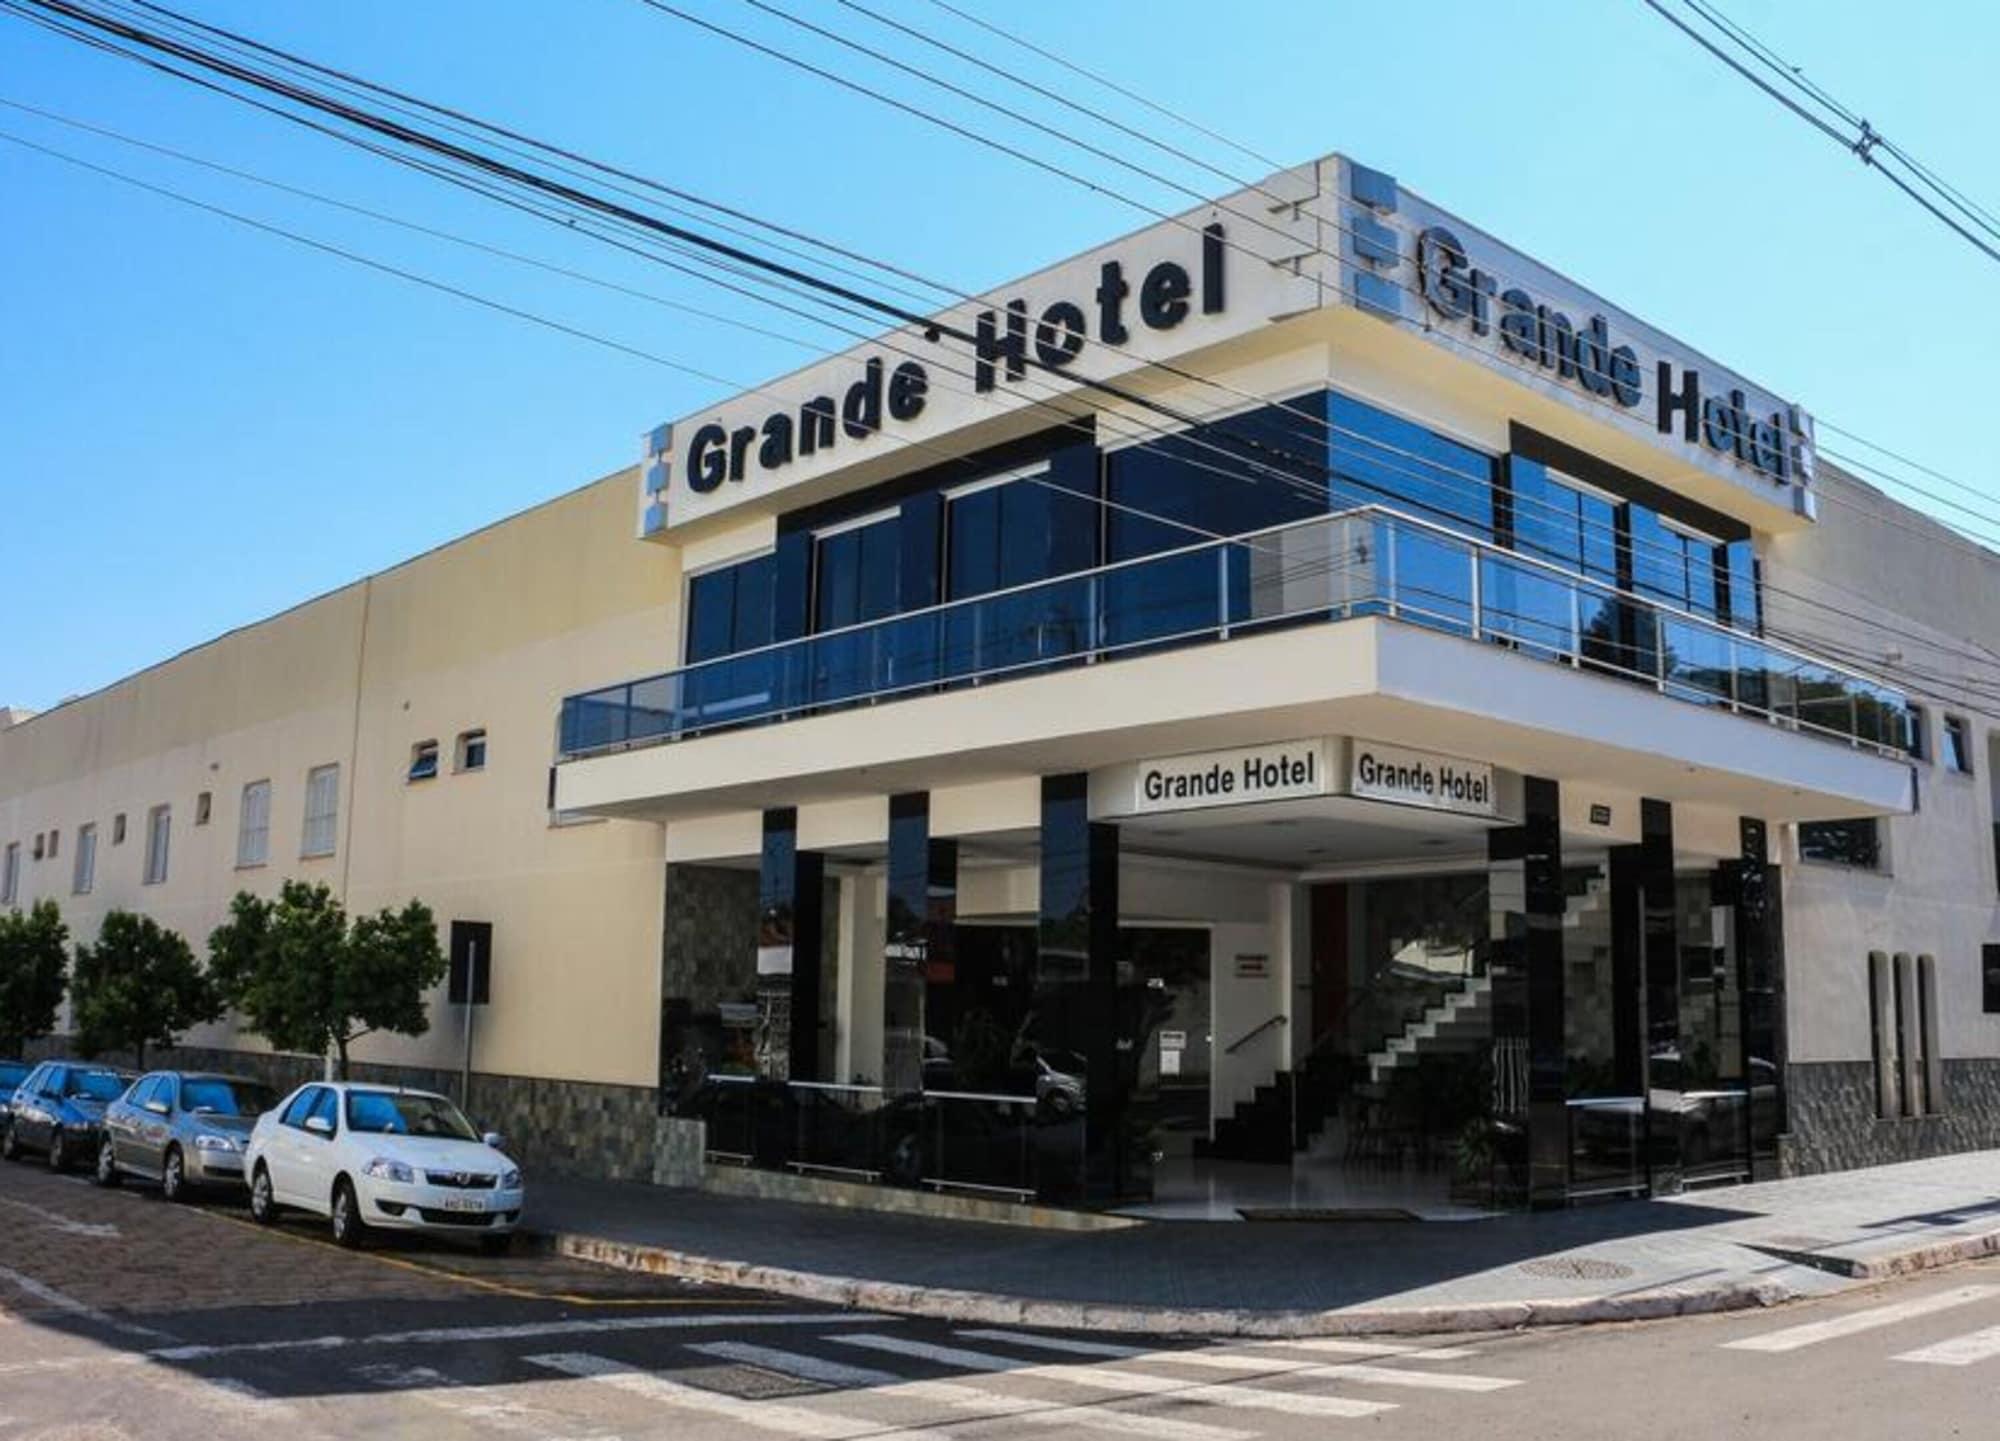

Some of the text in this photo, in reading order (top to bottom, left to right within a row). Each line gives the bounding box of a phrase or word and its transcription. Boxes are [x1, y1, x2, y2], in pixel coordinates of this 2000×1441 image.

[687, 223, 1226, 493] Grande Hotel
[1416, 226, 1787, 485] Grande Hotel
[1145, 751, 1314, 800] Grande Hotel
[1359, 753, 1489, 803] Grande Hotel
